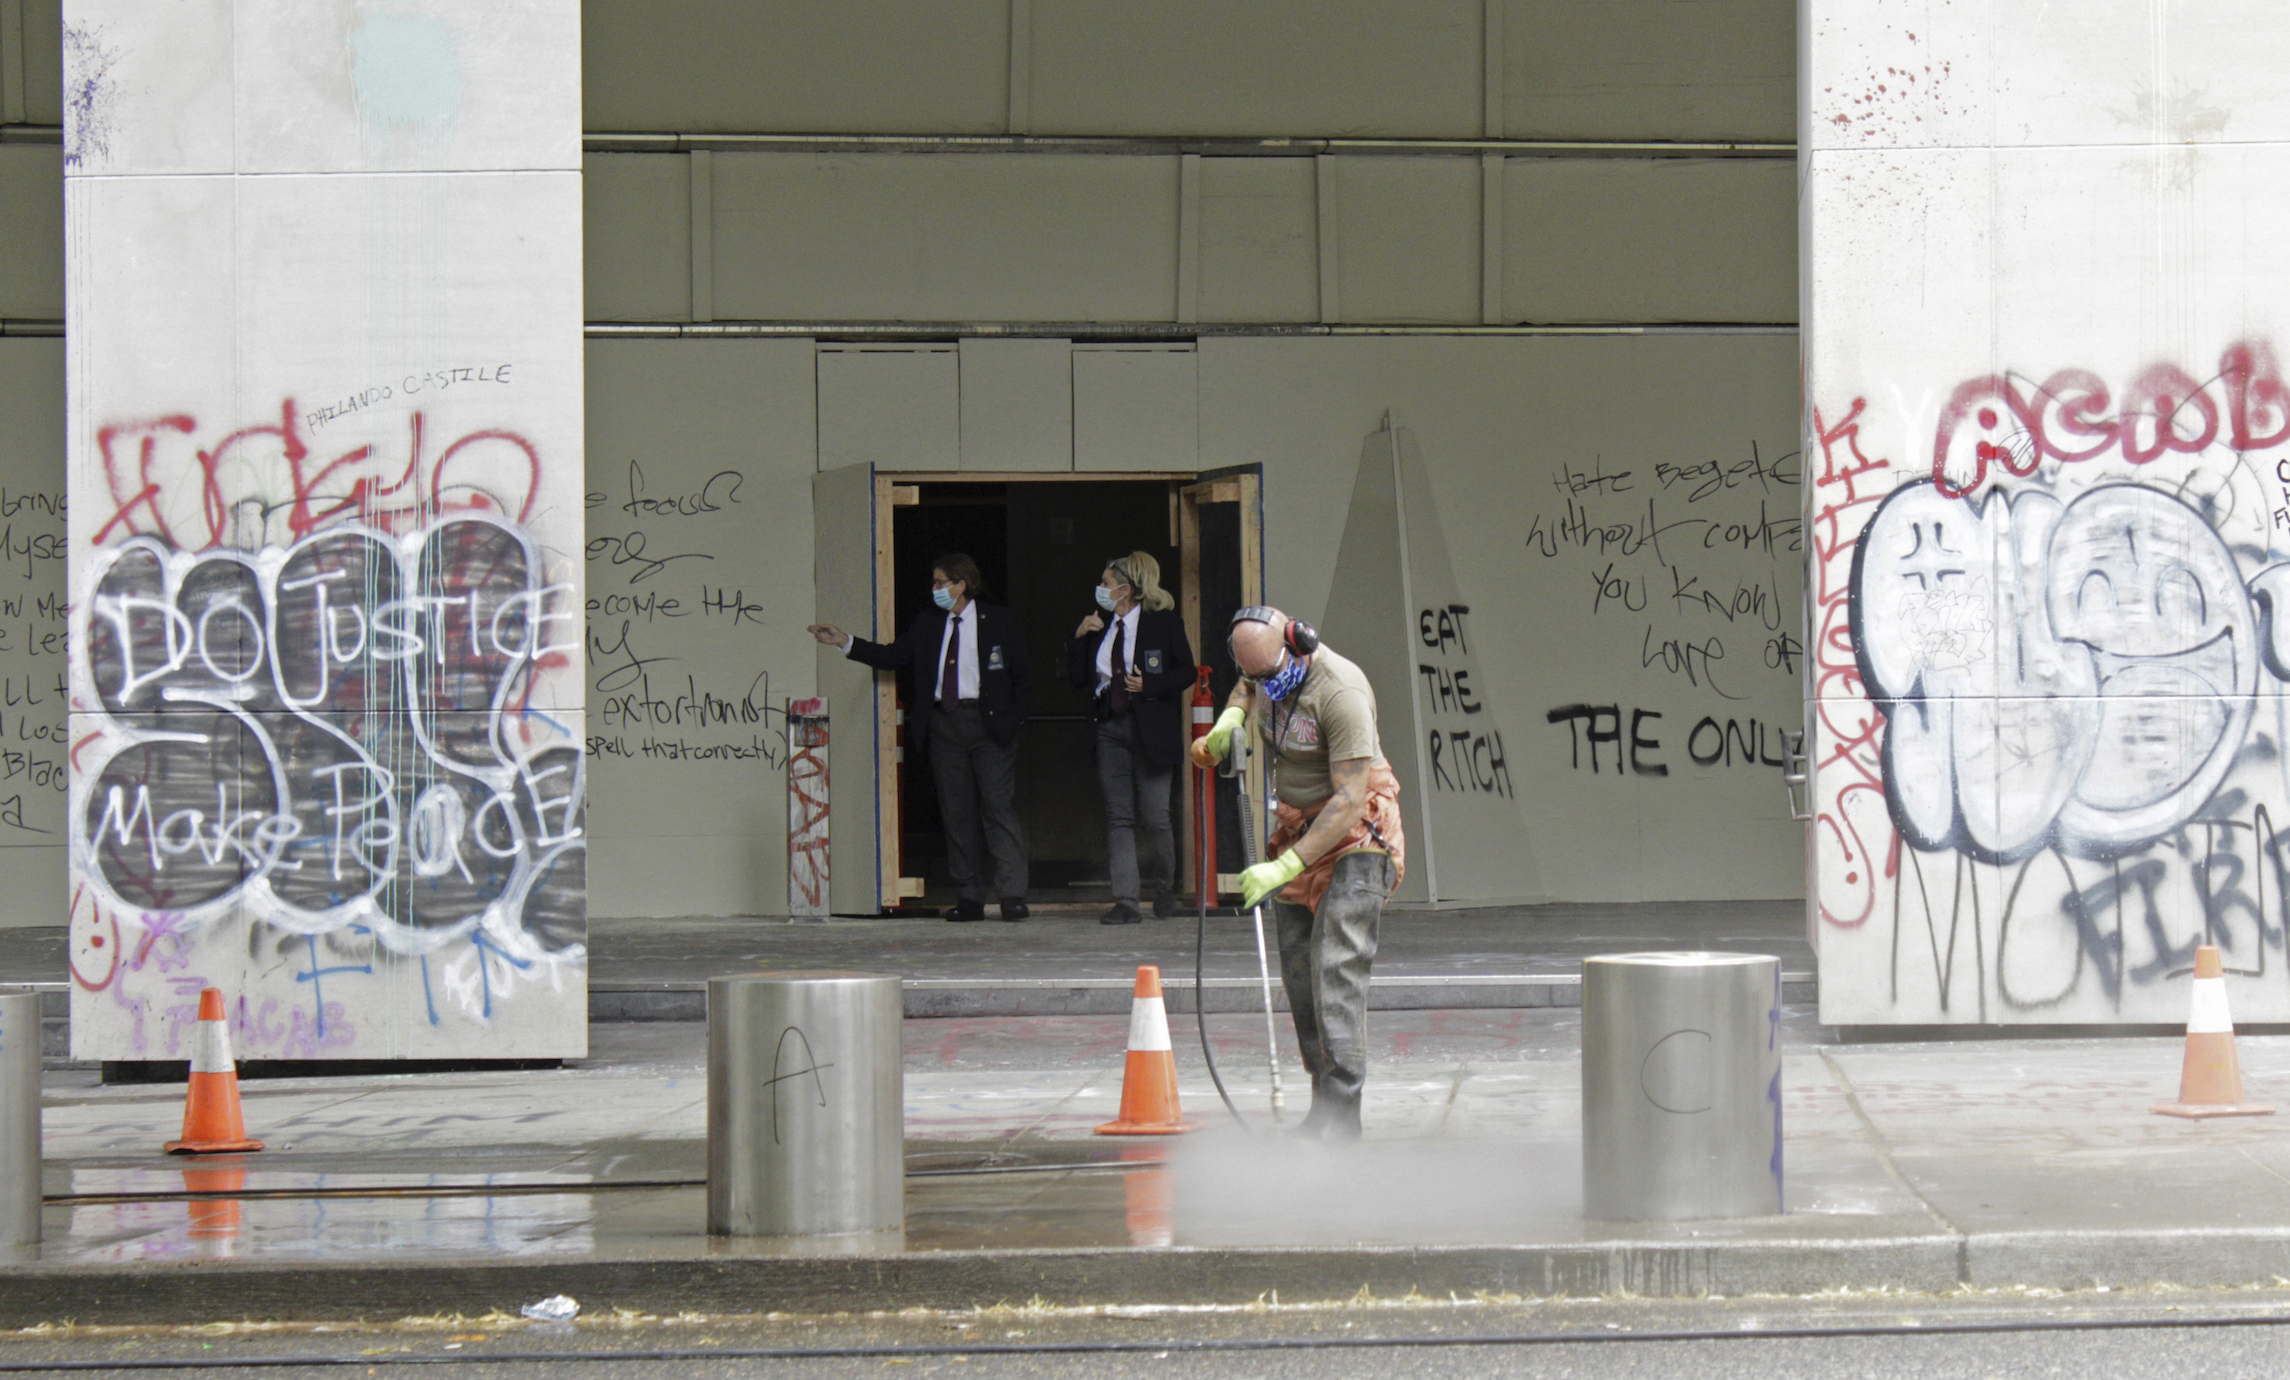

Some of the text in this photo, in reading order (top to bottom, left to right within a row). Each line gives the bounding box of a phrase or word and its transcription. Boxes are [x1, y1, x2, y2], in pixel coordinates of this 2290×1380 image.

[306, 363, 513, 436] PHILANDO CASTILE
[1552, 453, 1635, 498] Hate
[1420, 604, 1470, 656] EAT
[1419, 664, 1482, 714] THE
[1430, 729, 1514, 800] RITCH
[1546, 702, 1669, 777] THE
[90, 780, 302, 870] Make
[762, 1025, 835, 1145] A
[1639, 1028, 1712, 1114] C
